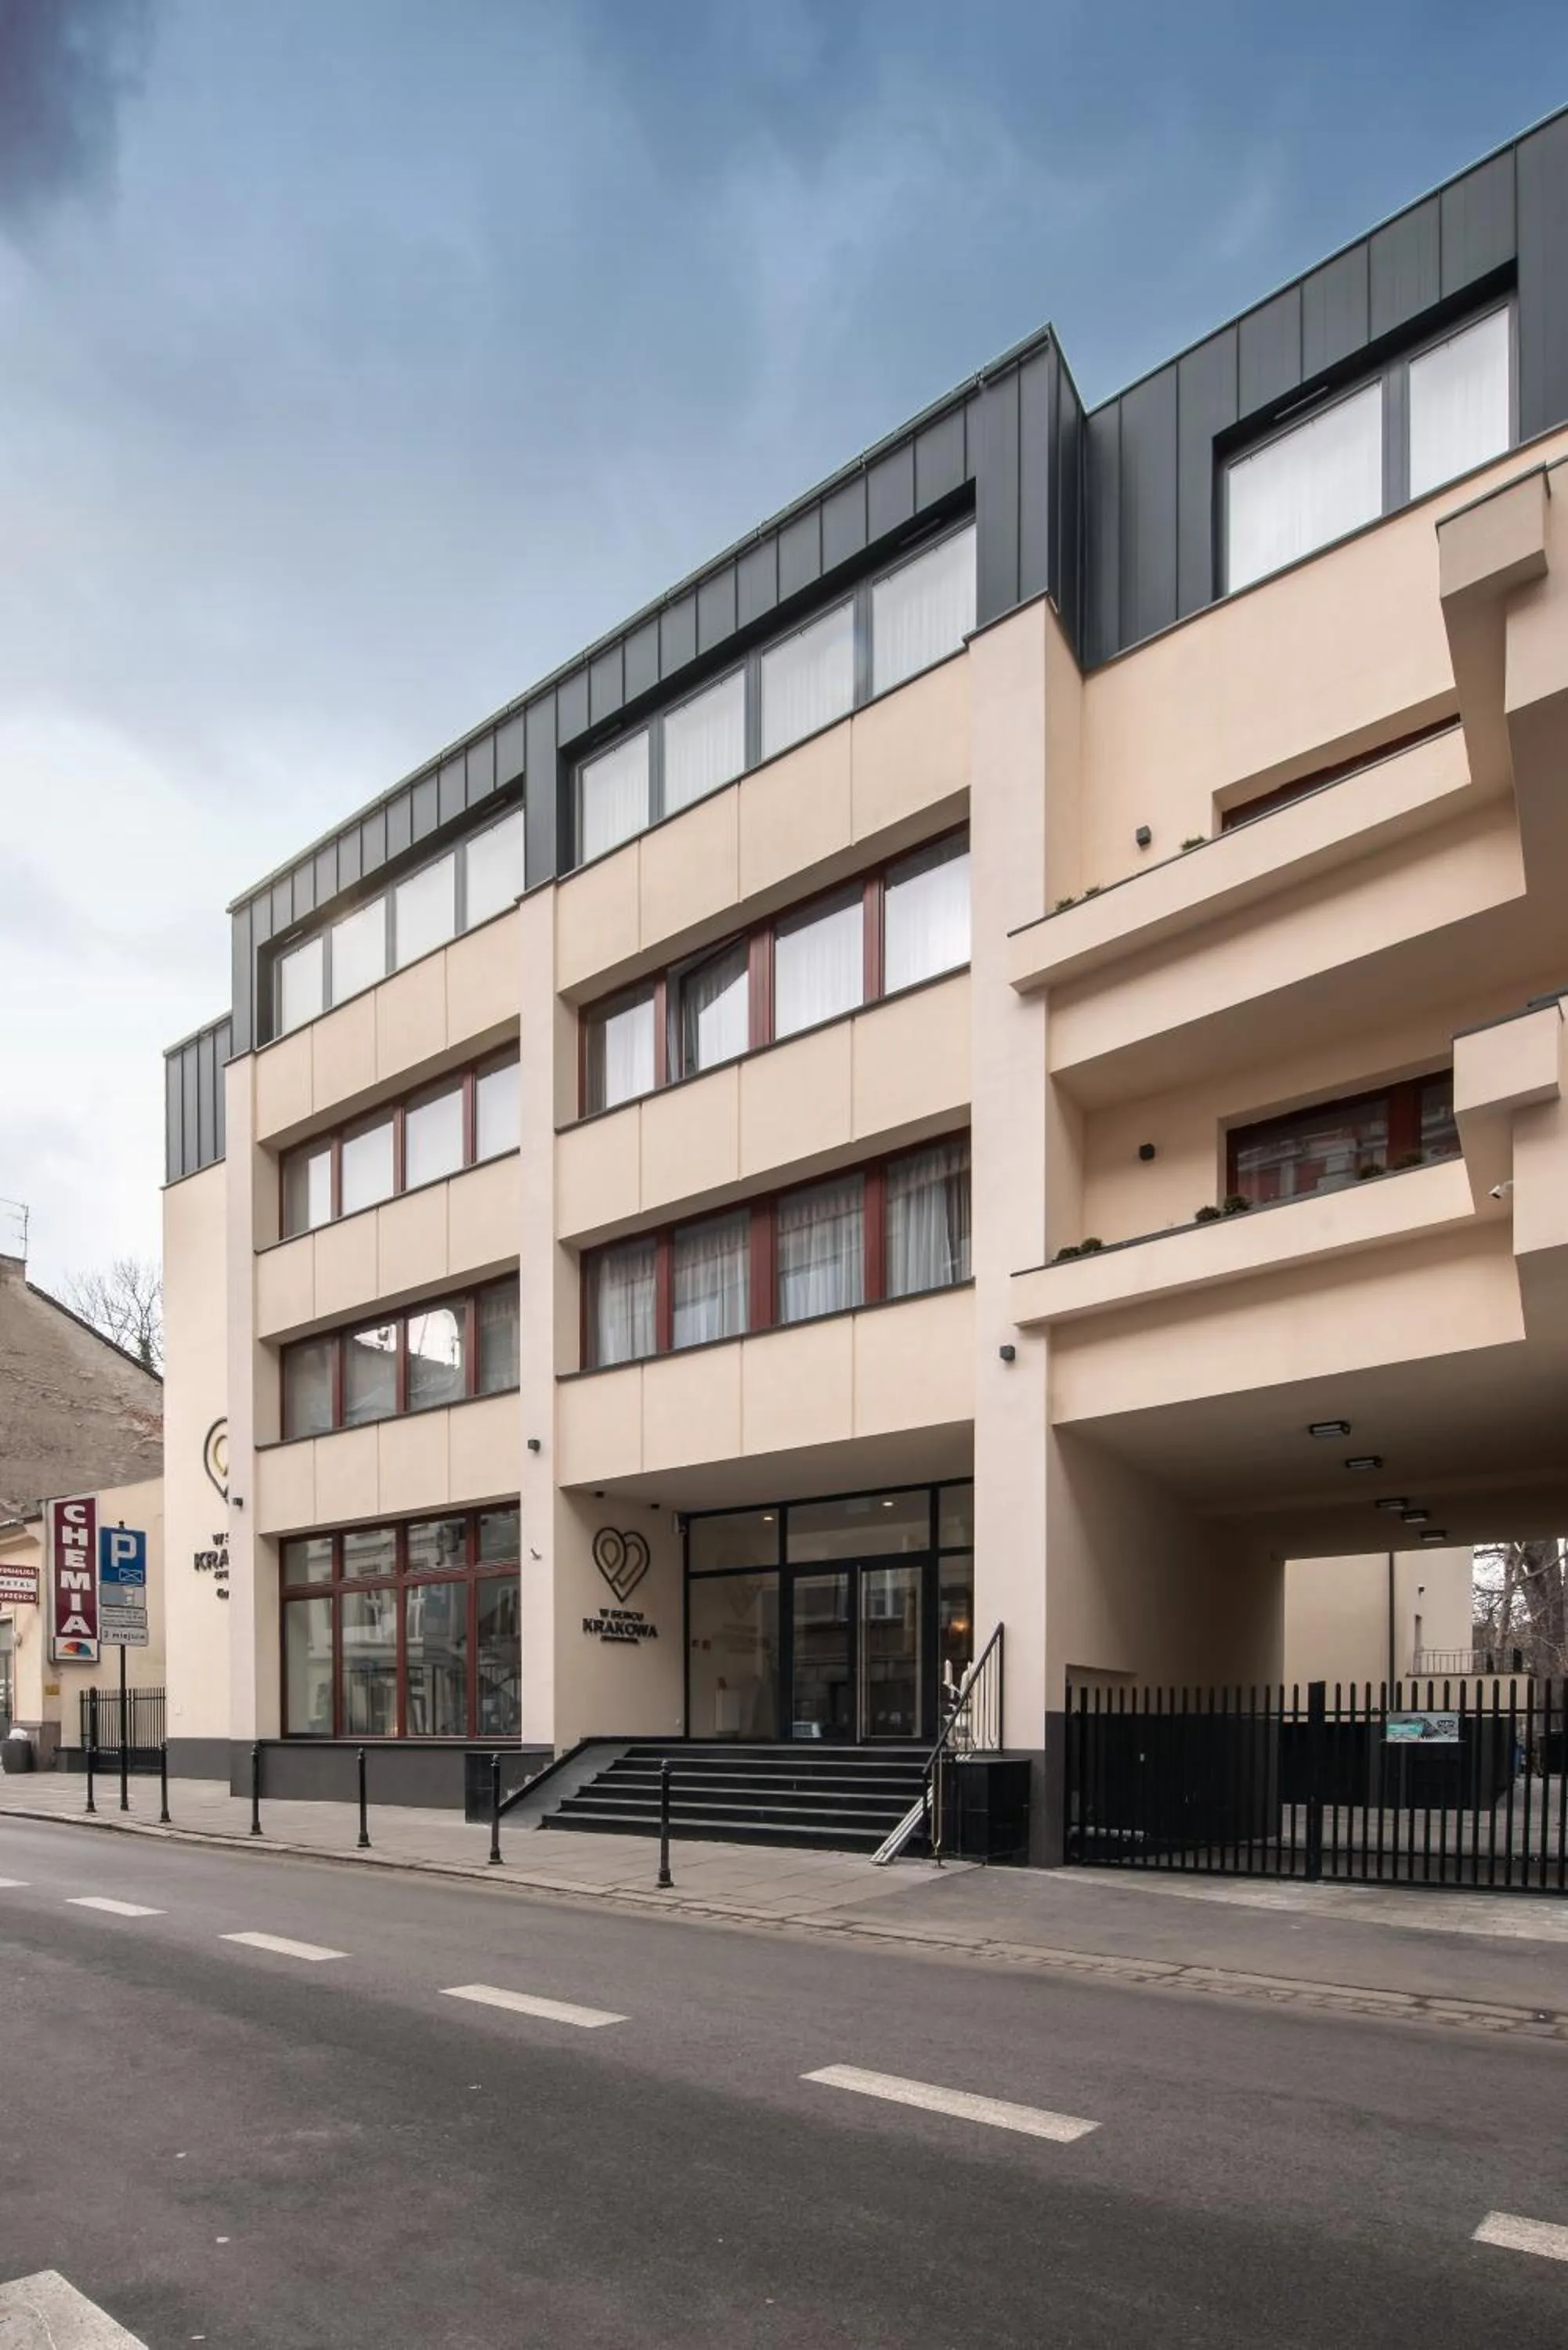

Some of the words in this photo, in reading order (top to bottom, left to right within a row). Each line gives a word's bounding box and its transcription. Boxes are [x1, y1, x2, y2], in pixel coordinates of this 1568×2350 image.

[110, 1533, 137, 1567] P
[193, 1549, 229, 1571] KRA
[60, 1504, 92, 1635] CHEMIA
[582, 1618, 658, 1639] KRAKOWA
